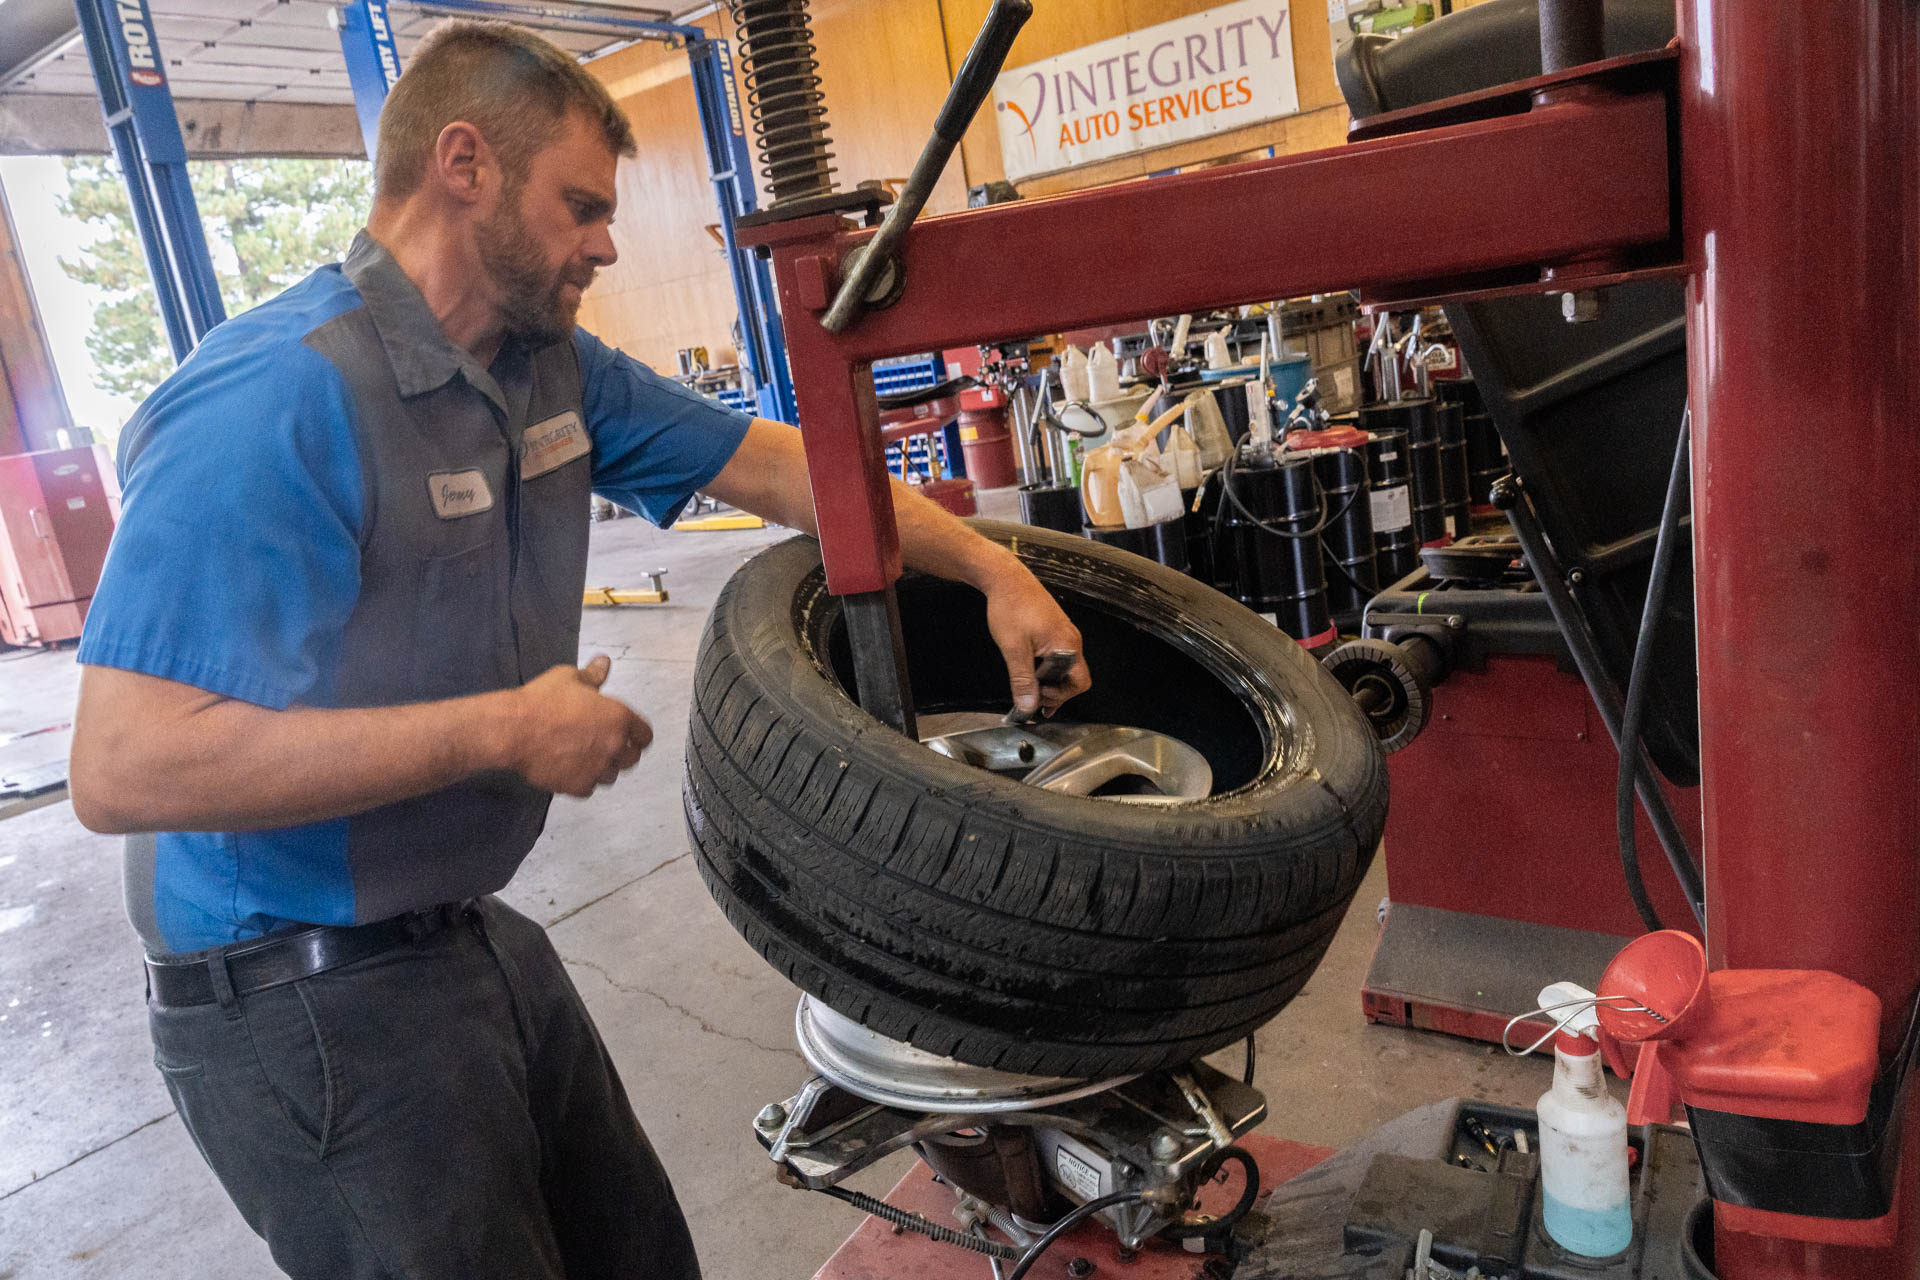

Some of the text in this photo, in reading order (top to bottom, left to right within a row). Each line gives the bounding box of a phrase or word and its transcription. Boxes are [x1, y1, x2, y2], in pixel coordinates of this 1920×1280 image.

[368, 0, 390, 40] LIFT
[716, 40, 742, 130] ROTARY LIFT
[1053, 9, 1288, 116] INTEGRITY
[1058, 76, 1253, 150] AUTO SERVICES
[1068, 1157, 1089, 1175] NOTICE
